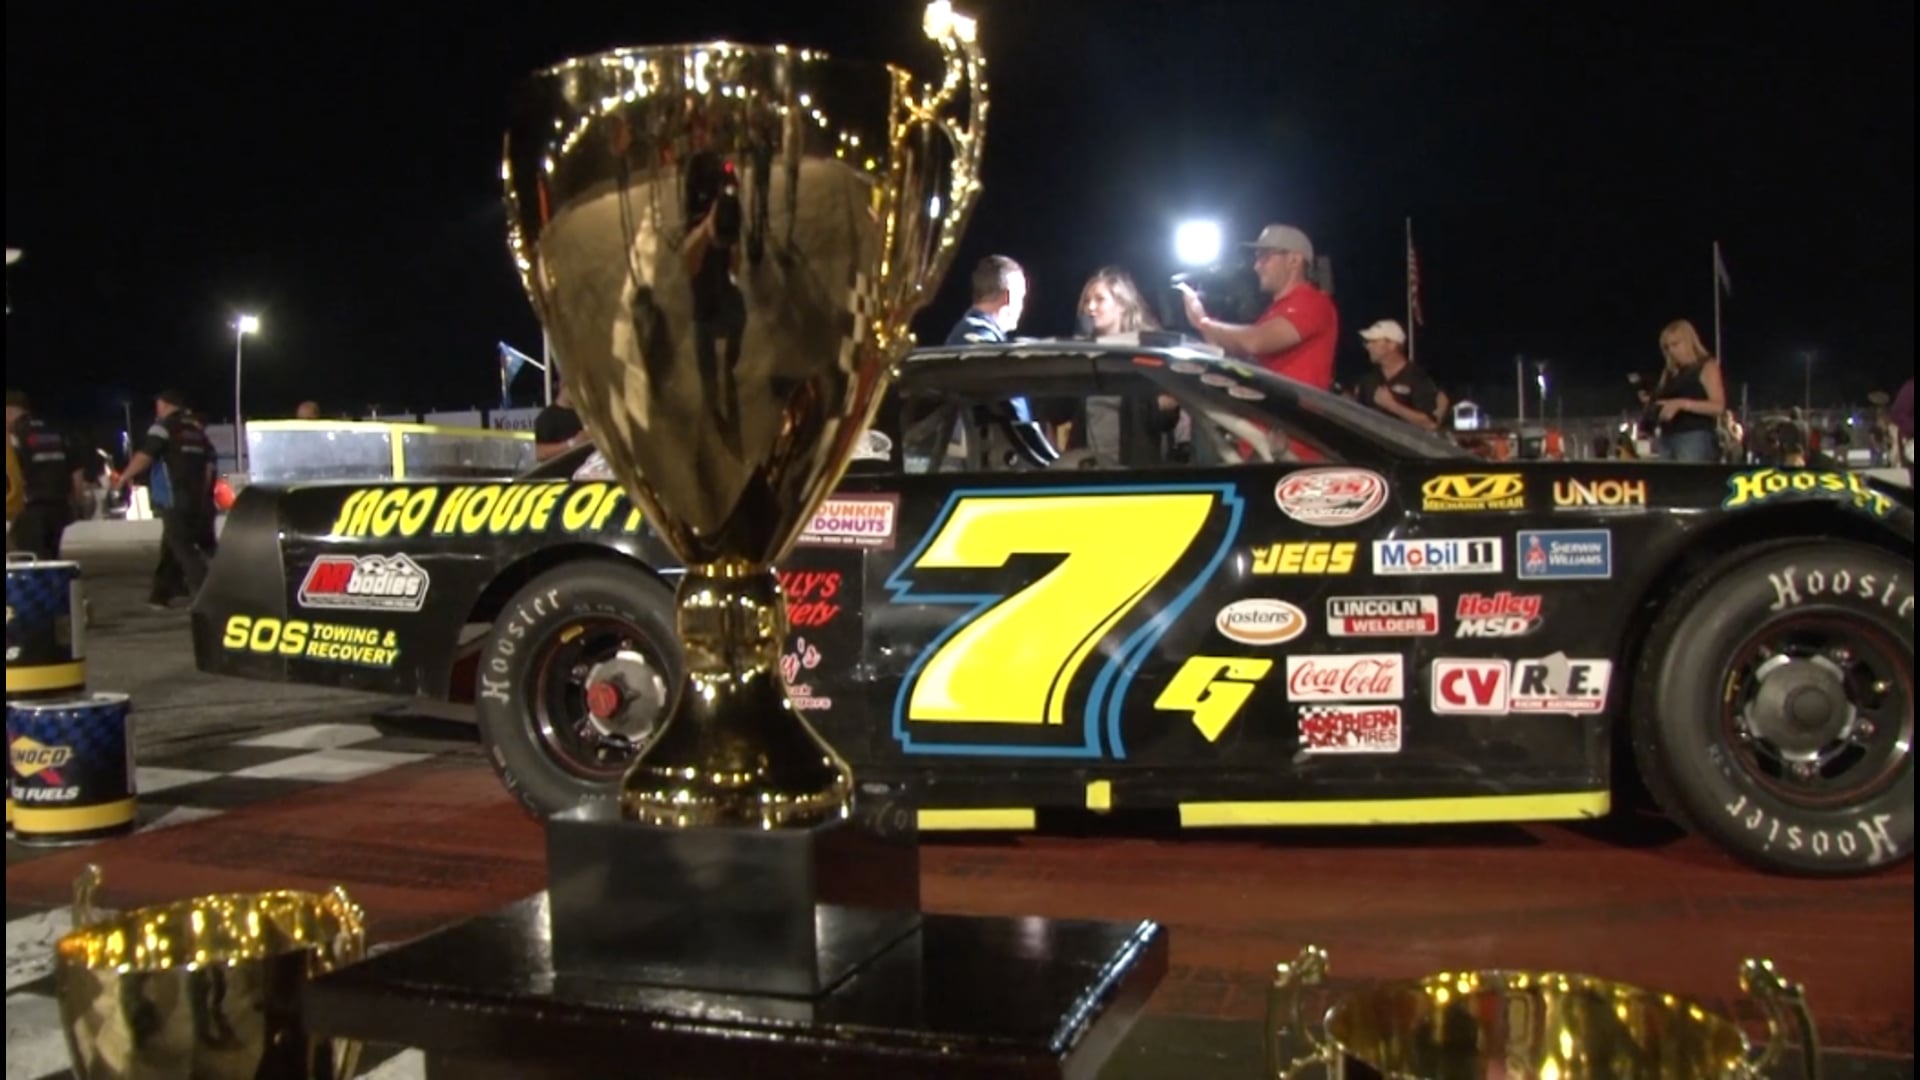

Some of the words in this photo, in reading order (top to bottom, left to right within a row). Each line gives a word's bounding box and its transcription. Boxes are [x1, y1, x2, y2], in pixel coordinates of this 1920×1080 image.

[1487, 496, 1524, 509] WEAR
[1553, 478, 1645, 505] UNOH
[1723, 469, 1893, 517] Hoosier
[333, 485, 438, 538] SACO
[432, 482, 569, 537] HOUSE
[815, 518, 885, 532] DONUTS
[1252, 542, 1357, 575] JEGS
[1381, 541, 1458, 566] Mobil
[1470, 542, 1491, 564] 1
[347, 570, 422, 596] bodies
[897, 489, 1228, 744] 7
[1224, 606, 1289, 629] jostens
[1332, 599, 1418, 617] LINCOLN
[1457, 592, 1541, 621] Holley
[222, 615, 310, 655] SOS
[312, 623, 381, 644] TOWING
[382, 630, 397, 646] &
[1352, 618, 1426, 632] WELDERS
[1455, 617, 1529, 638] MSD
[306, 641, 400, 665] RECOVERY
[482, 588, 560, 704] Hoosier
[1440, 668, 1501, 705] CV
[25, 786, 80, 802] FUELS
[1726, 794, 1898, 866] Hoosier
